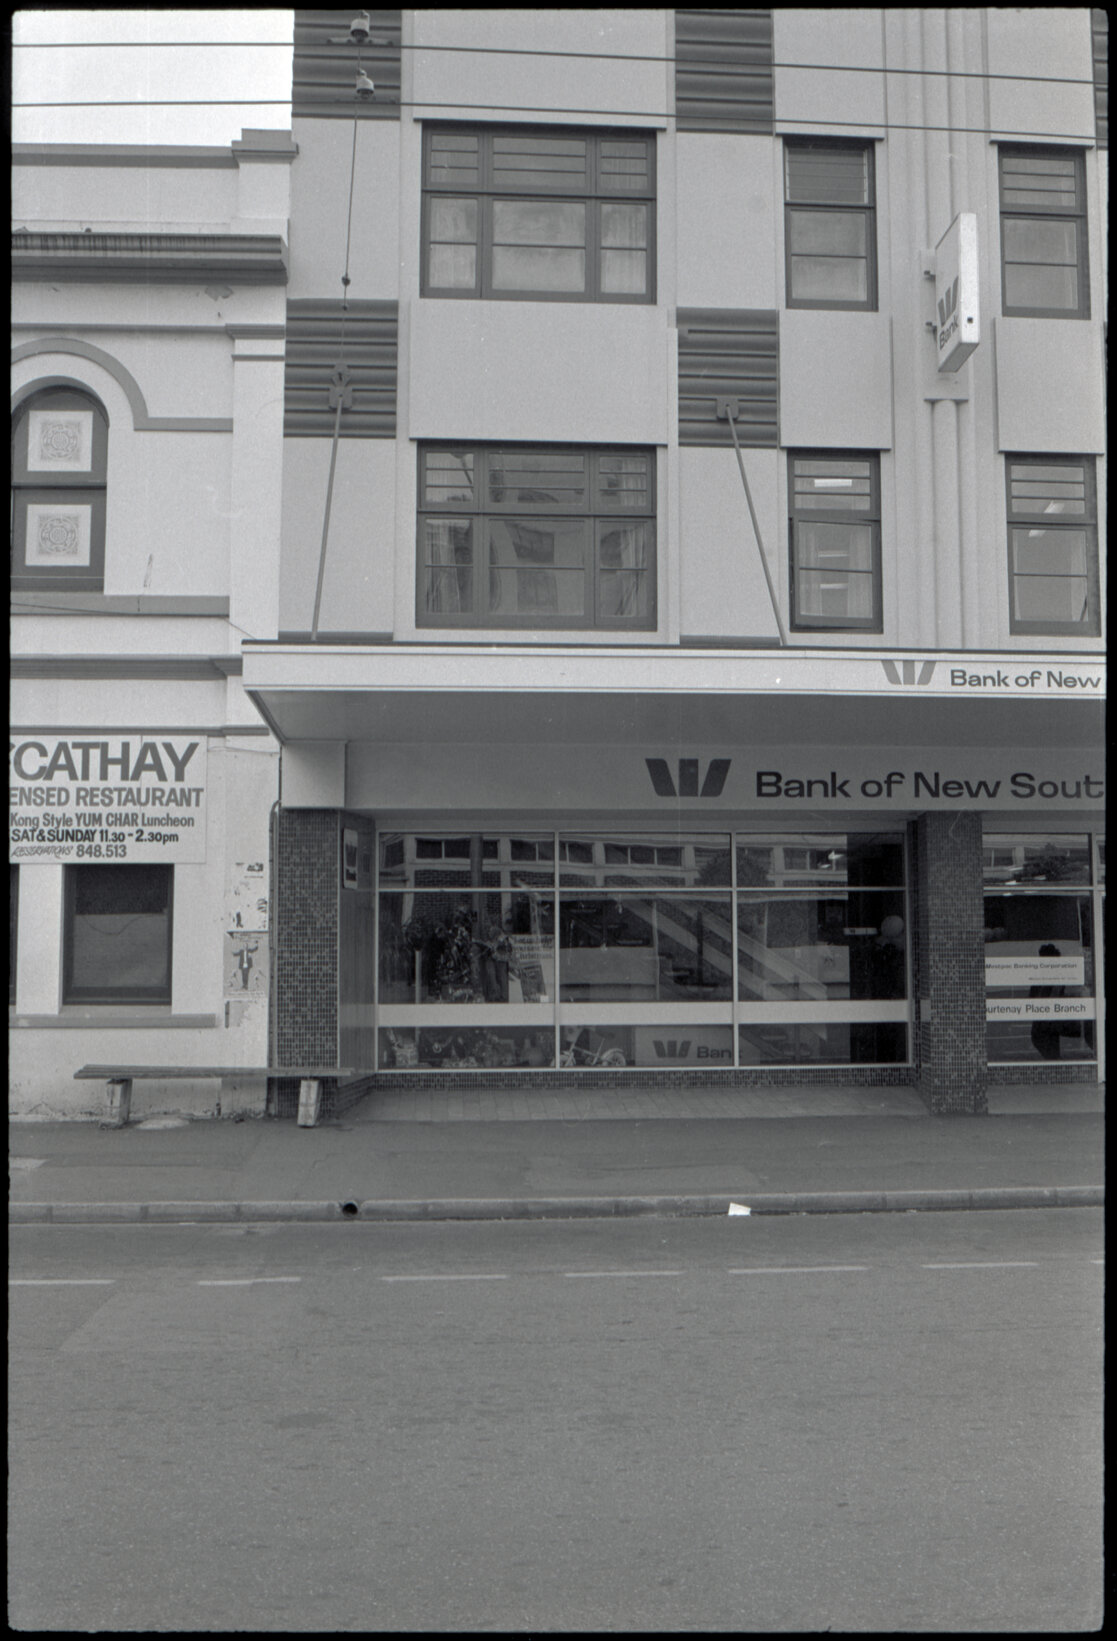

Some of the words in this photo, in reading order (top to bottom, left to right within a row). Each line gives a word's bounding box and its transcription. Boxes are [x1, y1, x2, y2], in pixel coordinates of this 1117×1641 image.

[939, 315, 959, 350] Bank
[950, 669, 1008, 688] Bank
[1014, 670, 1042, 688] of
[1046, 671, 1101, 689] New
[13, 741, 200, 782] CATHAY
[755, 771, 851, 799] Bank
[860, 771, 906, 799] of
[913, 772, 1001, 799] New
[1010, 772, 1105, 800] Sout
[9, 786, 70, 807] ENSED
[75, 787, 204, 808] RESTAURANT
[10, 812, 40, 829] Kong
[42, 812, 73, 829] Style
[75, 813, 102, 827] YUM
[105, 812, 139, 827] CHAR
[141, 813, 195, 827] Luncheon
[99, 829, 125, 843] 11.30
[135, 829, 179, 845] 2.30pm
[11, 845, 73, 859] RESERVATIONS
[76, 844, 127, 858] 848.513
[1039, 962, 1078, 970] Corporation
[985, 1004, 1021, 1014] urtenay
[1025, 1004, 1050, 1013] Place
[1054, 1003, 1086, 1013] Branch
[696, 1046, 742, 1059] Ban
